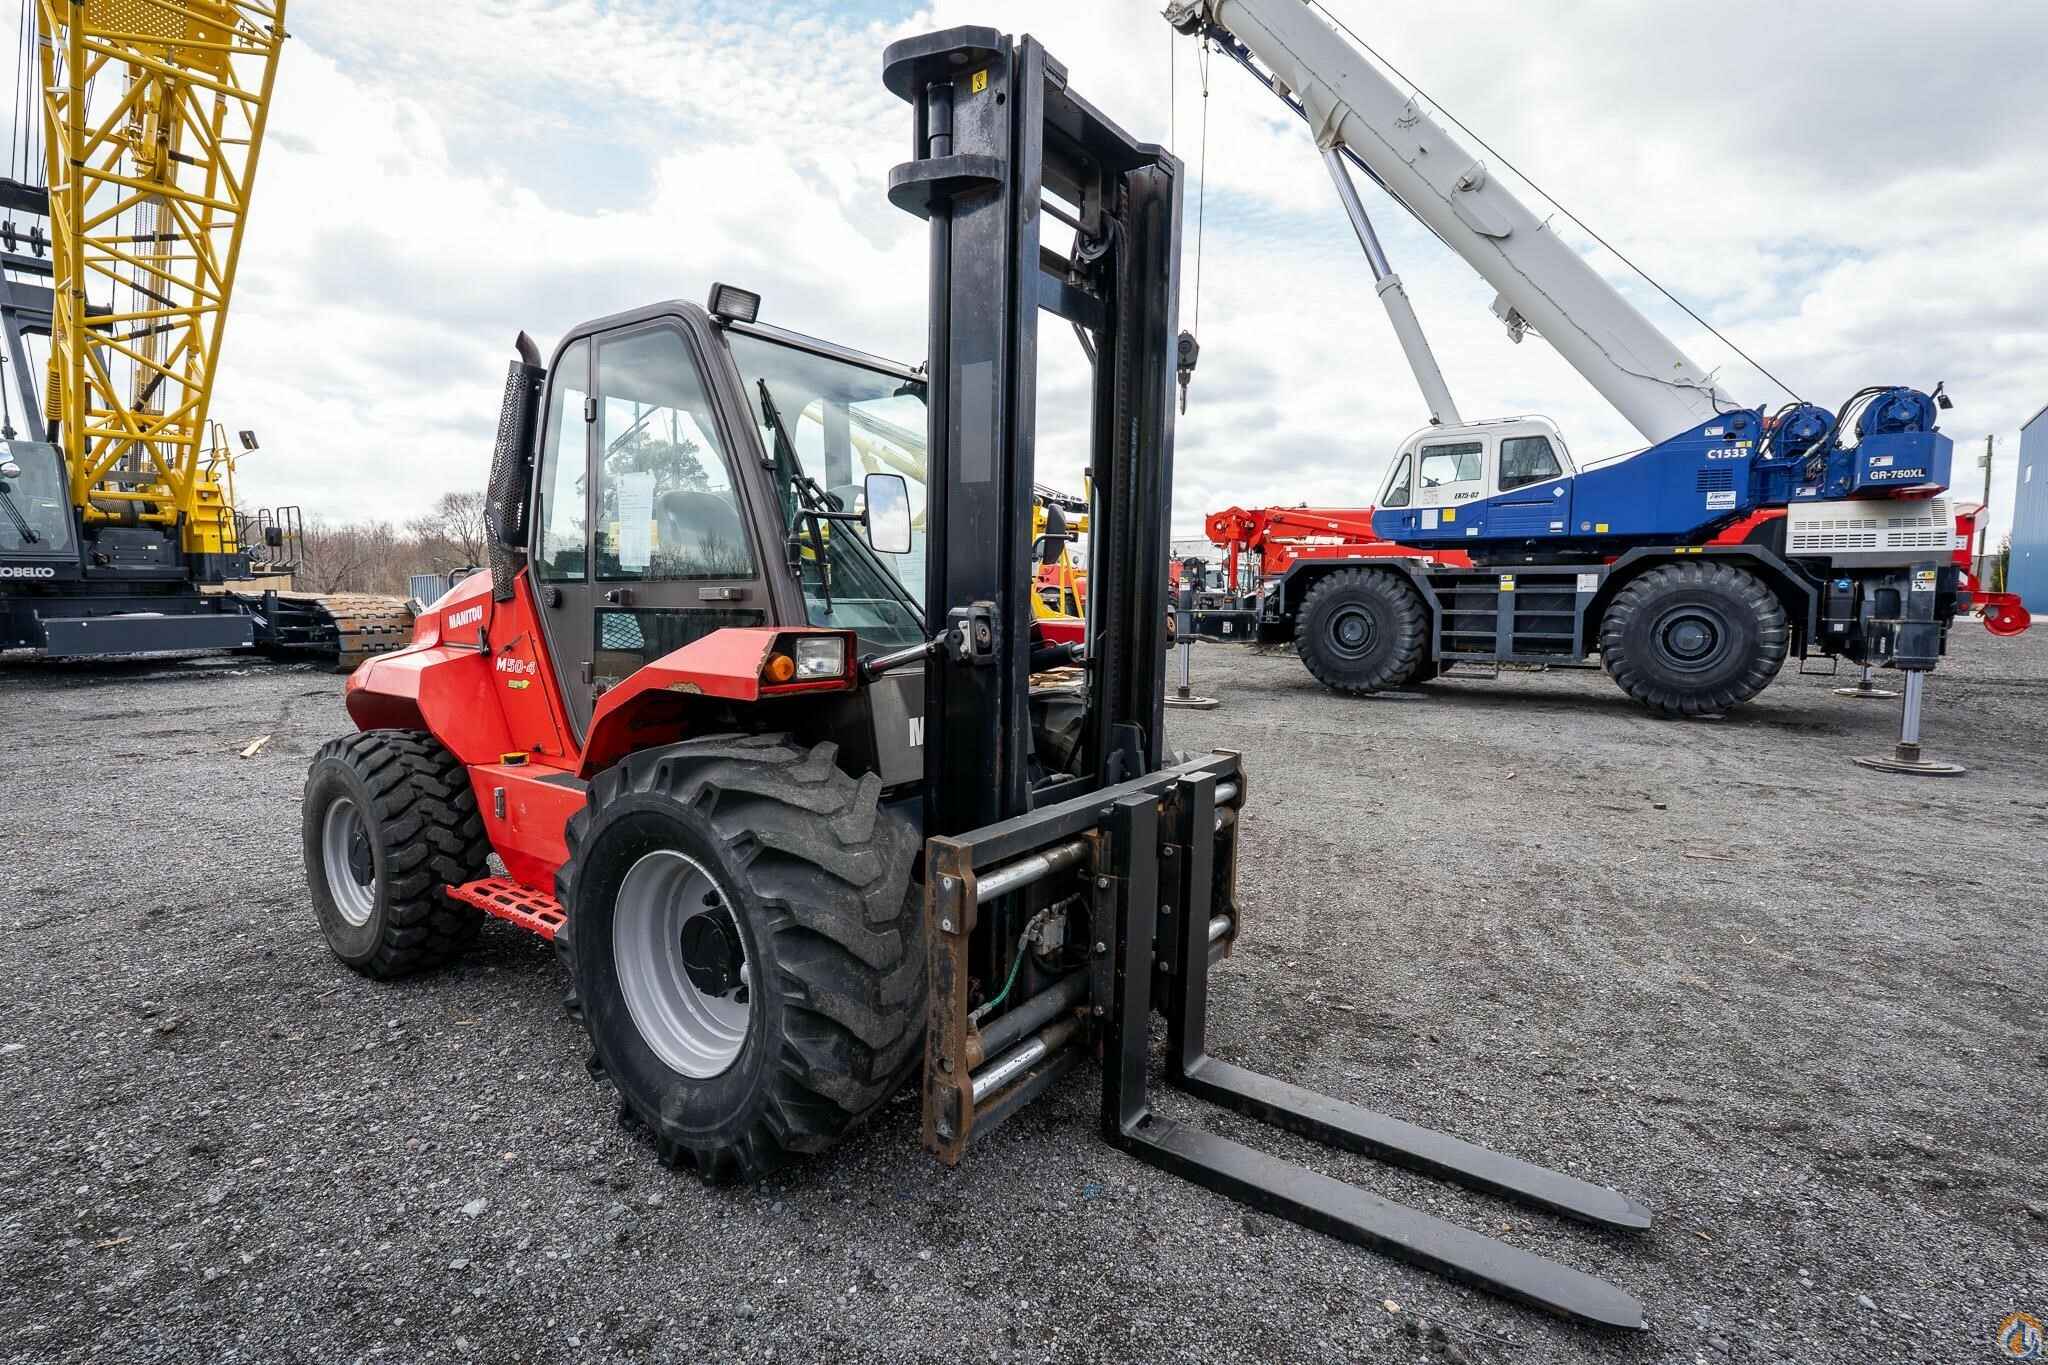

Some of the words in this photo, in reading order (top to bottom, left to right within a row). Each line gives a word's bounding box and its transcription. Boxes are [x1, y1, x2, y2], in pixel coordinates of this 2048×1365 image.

[1707, 448, 1748, 459] C1533
[1870, 468, 1925, 480] GR-750XL
[0, 567, 55, 578] OBELCO
[448, 605, 483, 629] MANITOU
